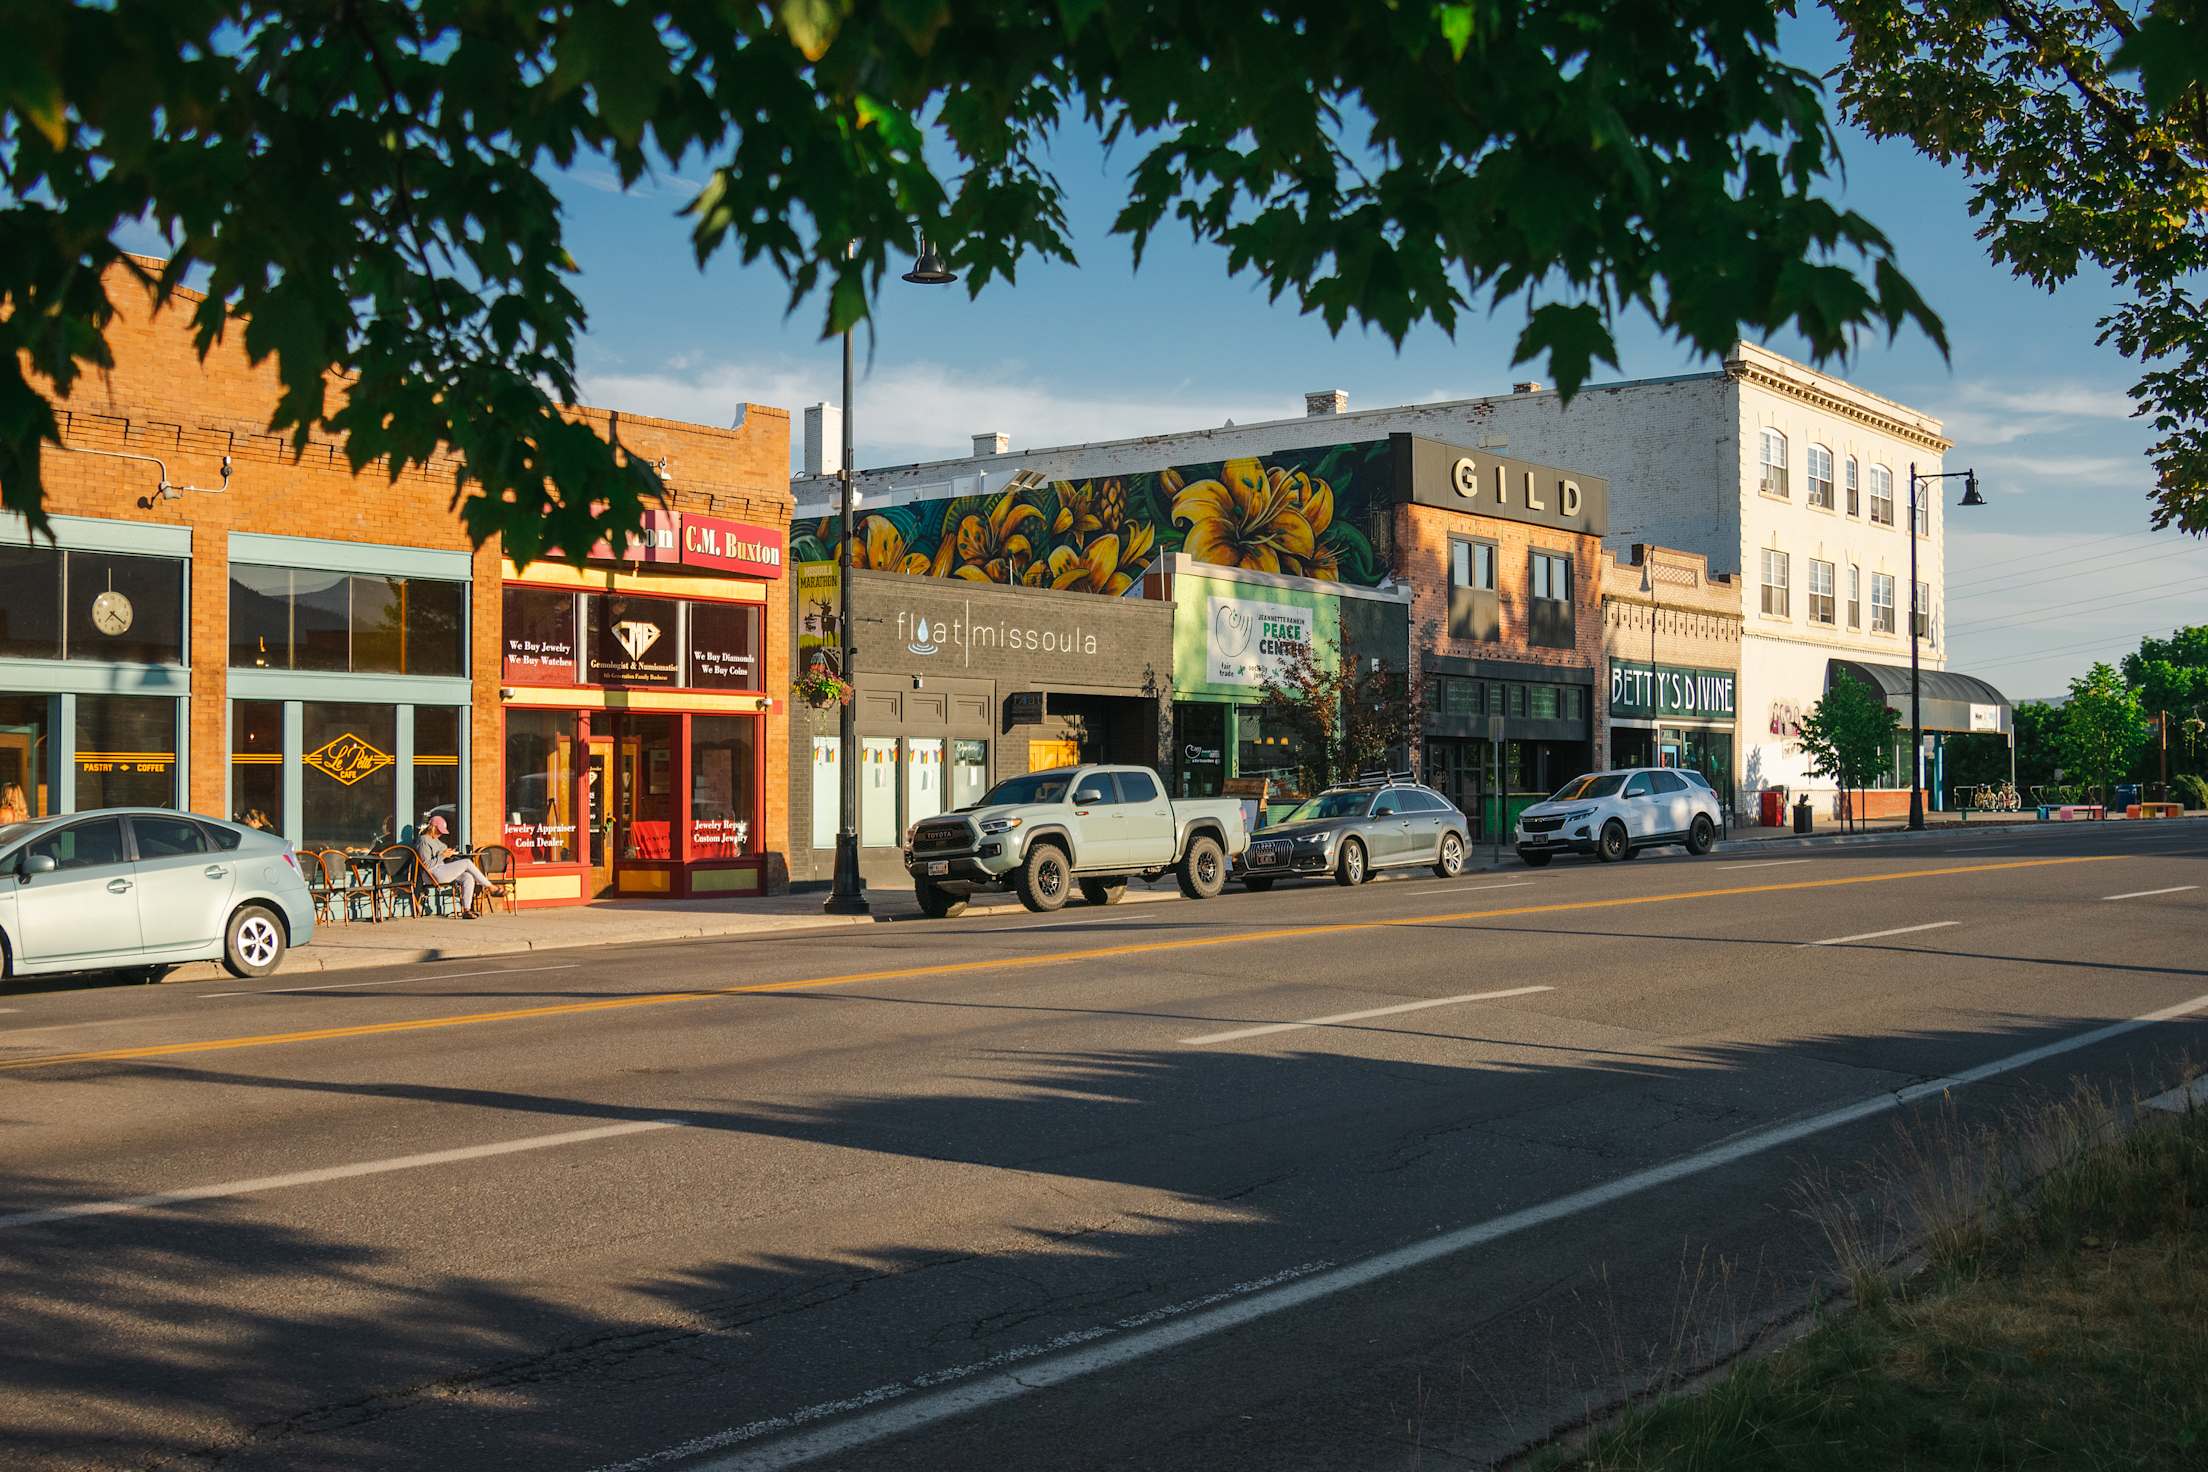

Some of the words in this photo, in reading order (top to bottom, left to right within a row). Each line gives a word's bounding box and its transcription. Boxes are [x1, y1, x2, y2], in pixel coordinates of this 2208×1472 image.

[1452, 457, 1582, 517] GILD
[685, 525, 721, 556] C.M.
[725, 532, 780, 566] Buxton
[800, 575, 838, 589] MARATHON
[1258, 614, 1286, 623] JEANNETTE
[1286, 617, 1305, 625] RANKIN
[972, 620, 1097, 655] missoula
[1263, 622, 1301, 640] PEACE
[509, 640, 523, 650] We
[524, 641, 540, 653] Buy
[541, 642, 571, 655] Jewelry
[508, 654, 521, 664] We
[523, 655, 539, 667] Buy
[540, 656, 572, 666] Watches
[694, 651, 706, 661] We
[707, 651, 721, 663] Buy
[722, 652, 755, 663] Diamonds
[590, 659, 629, 670] Gemologist
[630, 661, 637, 670] &
[638, 661, 679, 672] Numismatist
[701, 664, 713, 674] We
[714, 665, 728, 677] Buy
[729, 665, 748, 676] Coins
[1221, 661, 1231, 669] fair
[1219, 669, 1234, 677] trade
[1612, 667, 1681, 709] BETTY'S
[1685, 675, 1734, 712] DIVINE
[323, 743, 349, 771] Le
[346, 744, 374, 771] Petit
[83, 763, 113, 772] PASTRY
[137, 763, 165, 772] COFFEE
[504, 823, 535, 835] Jewelry
[536, 823, 576, 835] Appraiser
[694, 819, 722, 831] Jewelry
[515, 838, 535, 847] Coin
[536, 837, 564, 847] Dealer
[693, 833, 721, 843] Custom
[927, 831, 952, 840] TOYOTA
